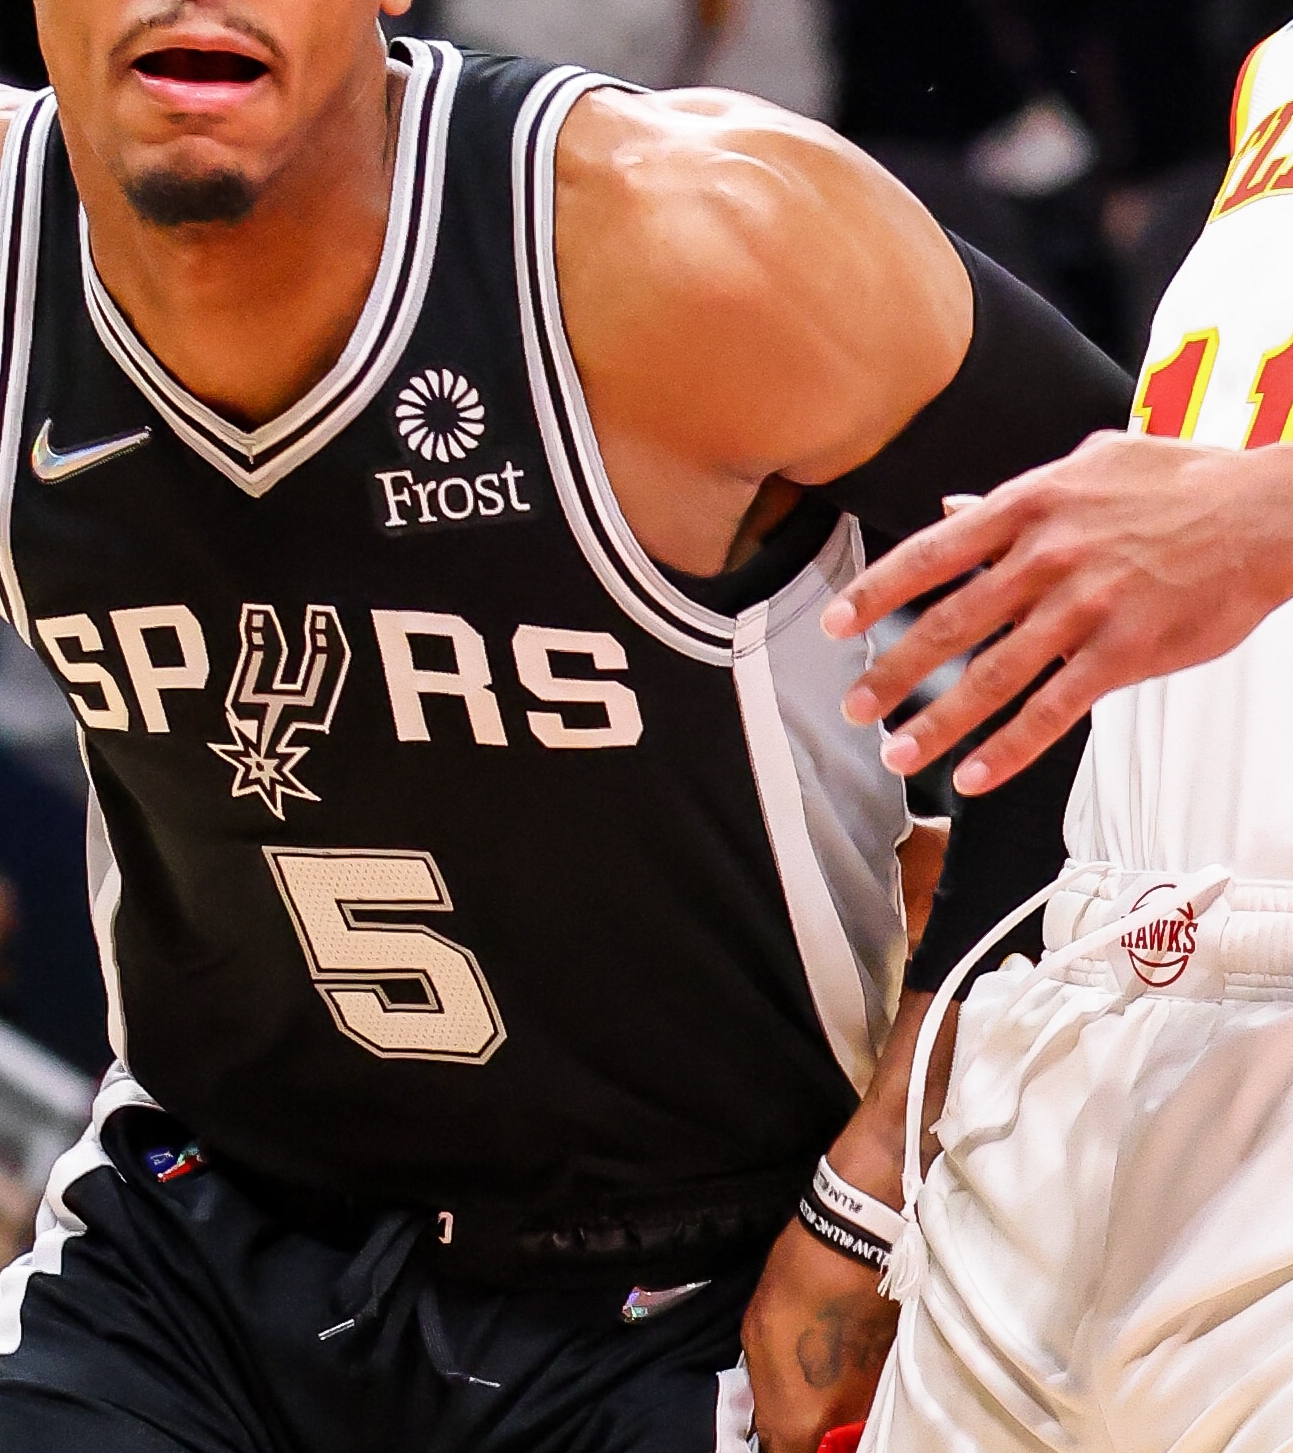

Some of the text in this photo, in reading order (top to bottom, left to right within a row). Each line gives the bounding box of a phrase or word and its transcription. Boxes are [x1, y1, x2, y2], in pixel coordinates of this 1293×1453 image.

[374, 460, 531, 527] Frost
[35, 604, 644, 820] SPURS
[262, 845, 508, 1066] 5
